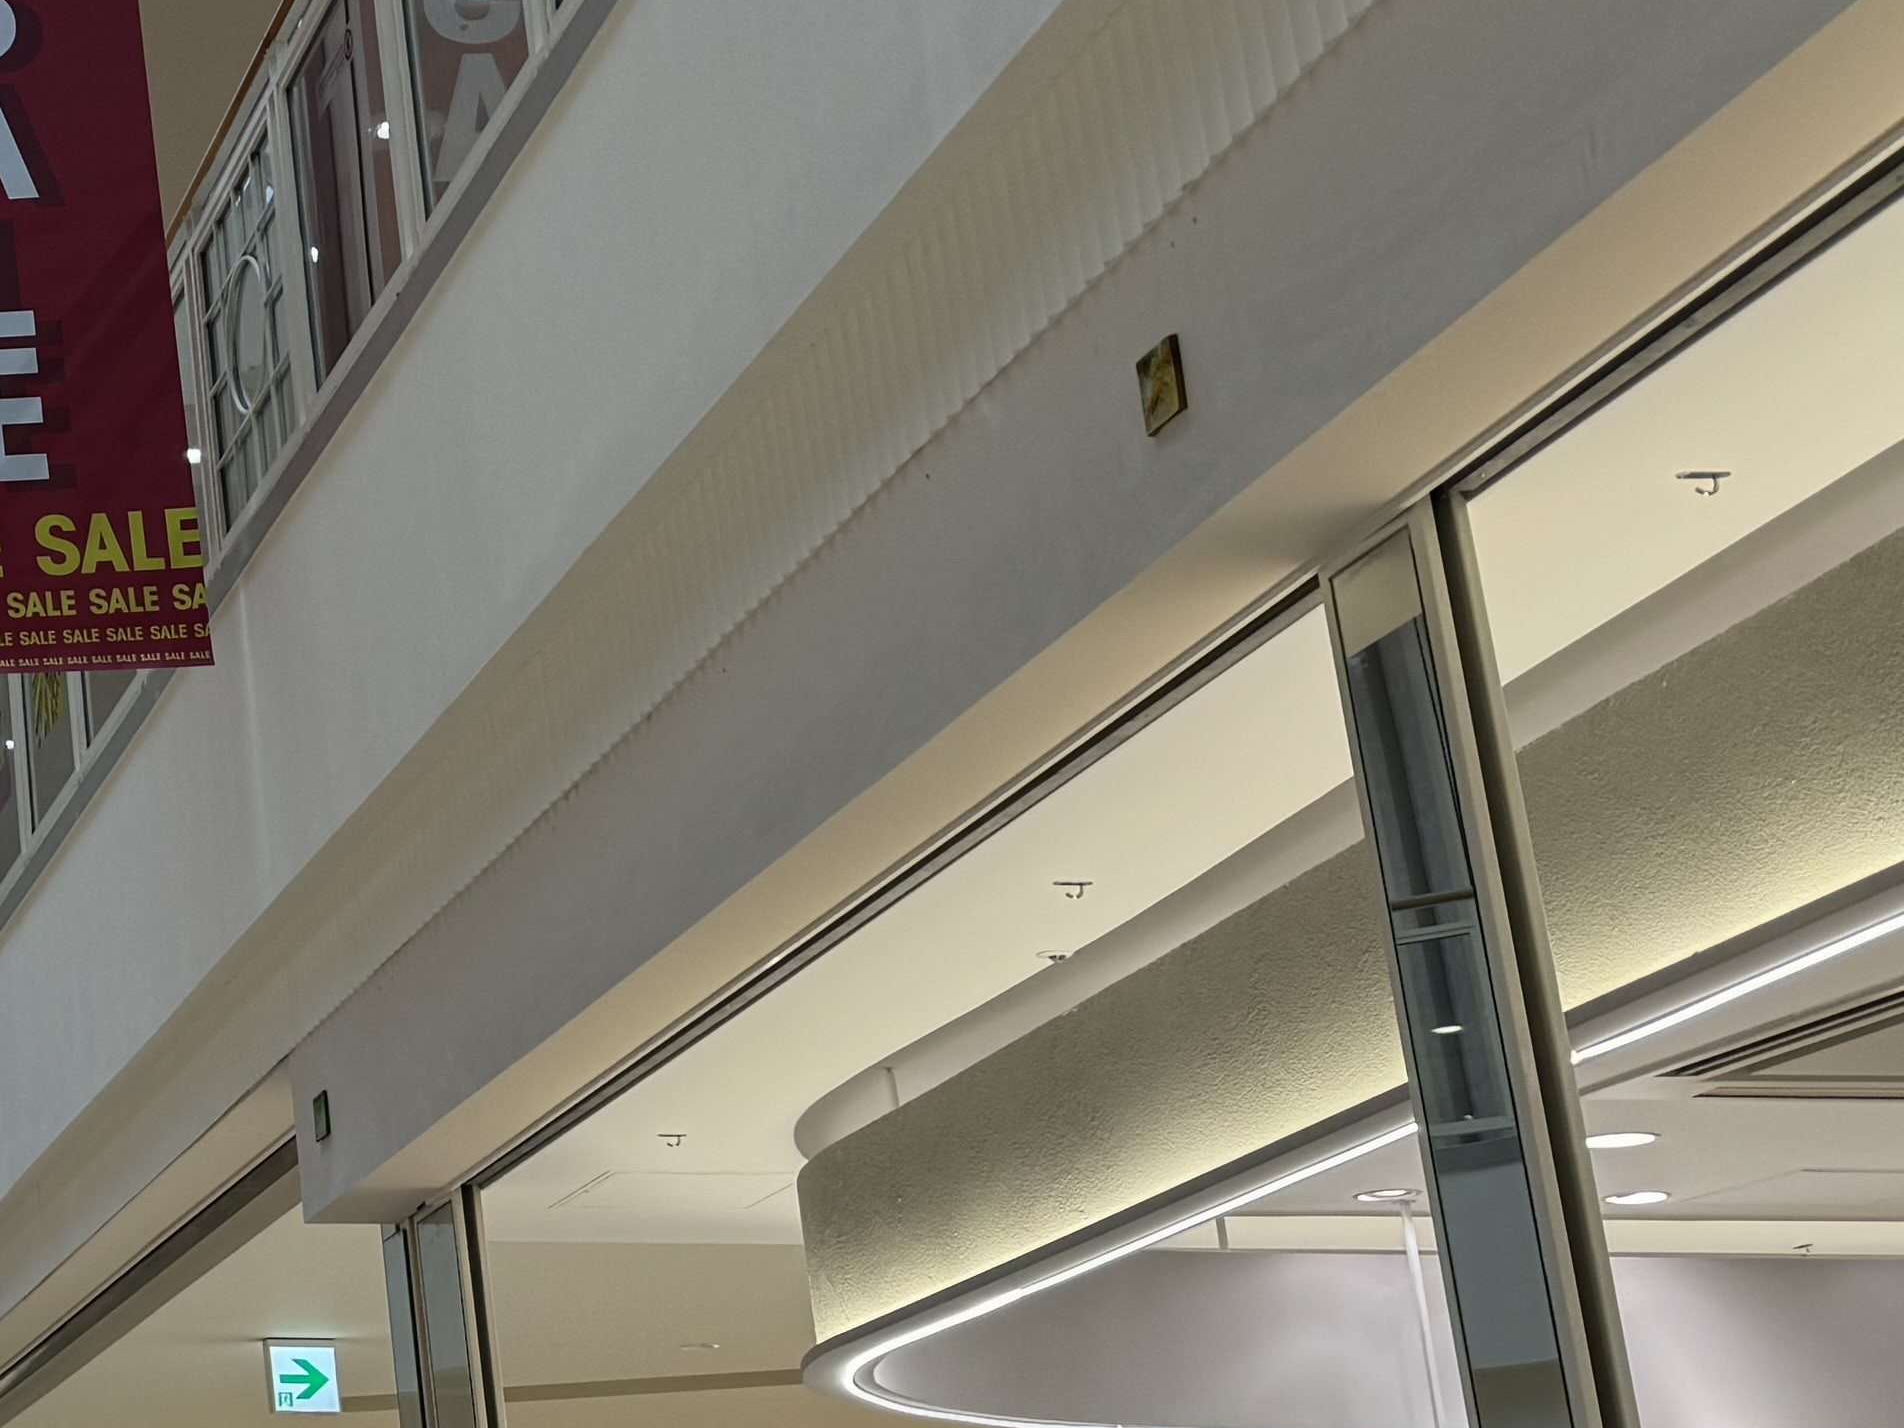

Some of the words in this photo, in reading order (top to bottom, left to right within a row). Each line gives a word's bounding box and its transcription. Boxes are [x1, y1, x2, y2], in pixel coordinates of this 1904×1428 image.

[34, 507, 202, 576] SALE
[6, 590, 77, 619] SALE
[88, 585, 160, 615] SALE
[19, 630, 57, 646] SALE
[62, 628, 100, 644] SALE
[106, 626, 144, 642] SALE
[150, 624, 188, 640] SALE
